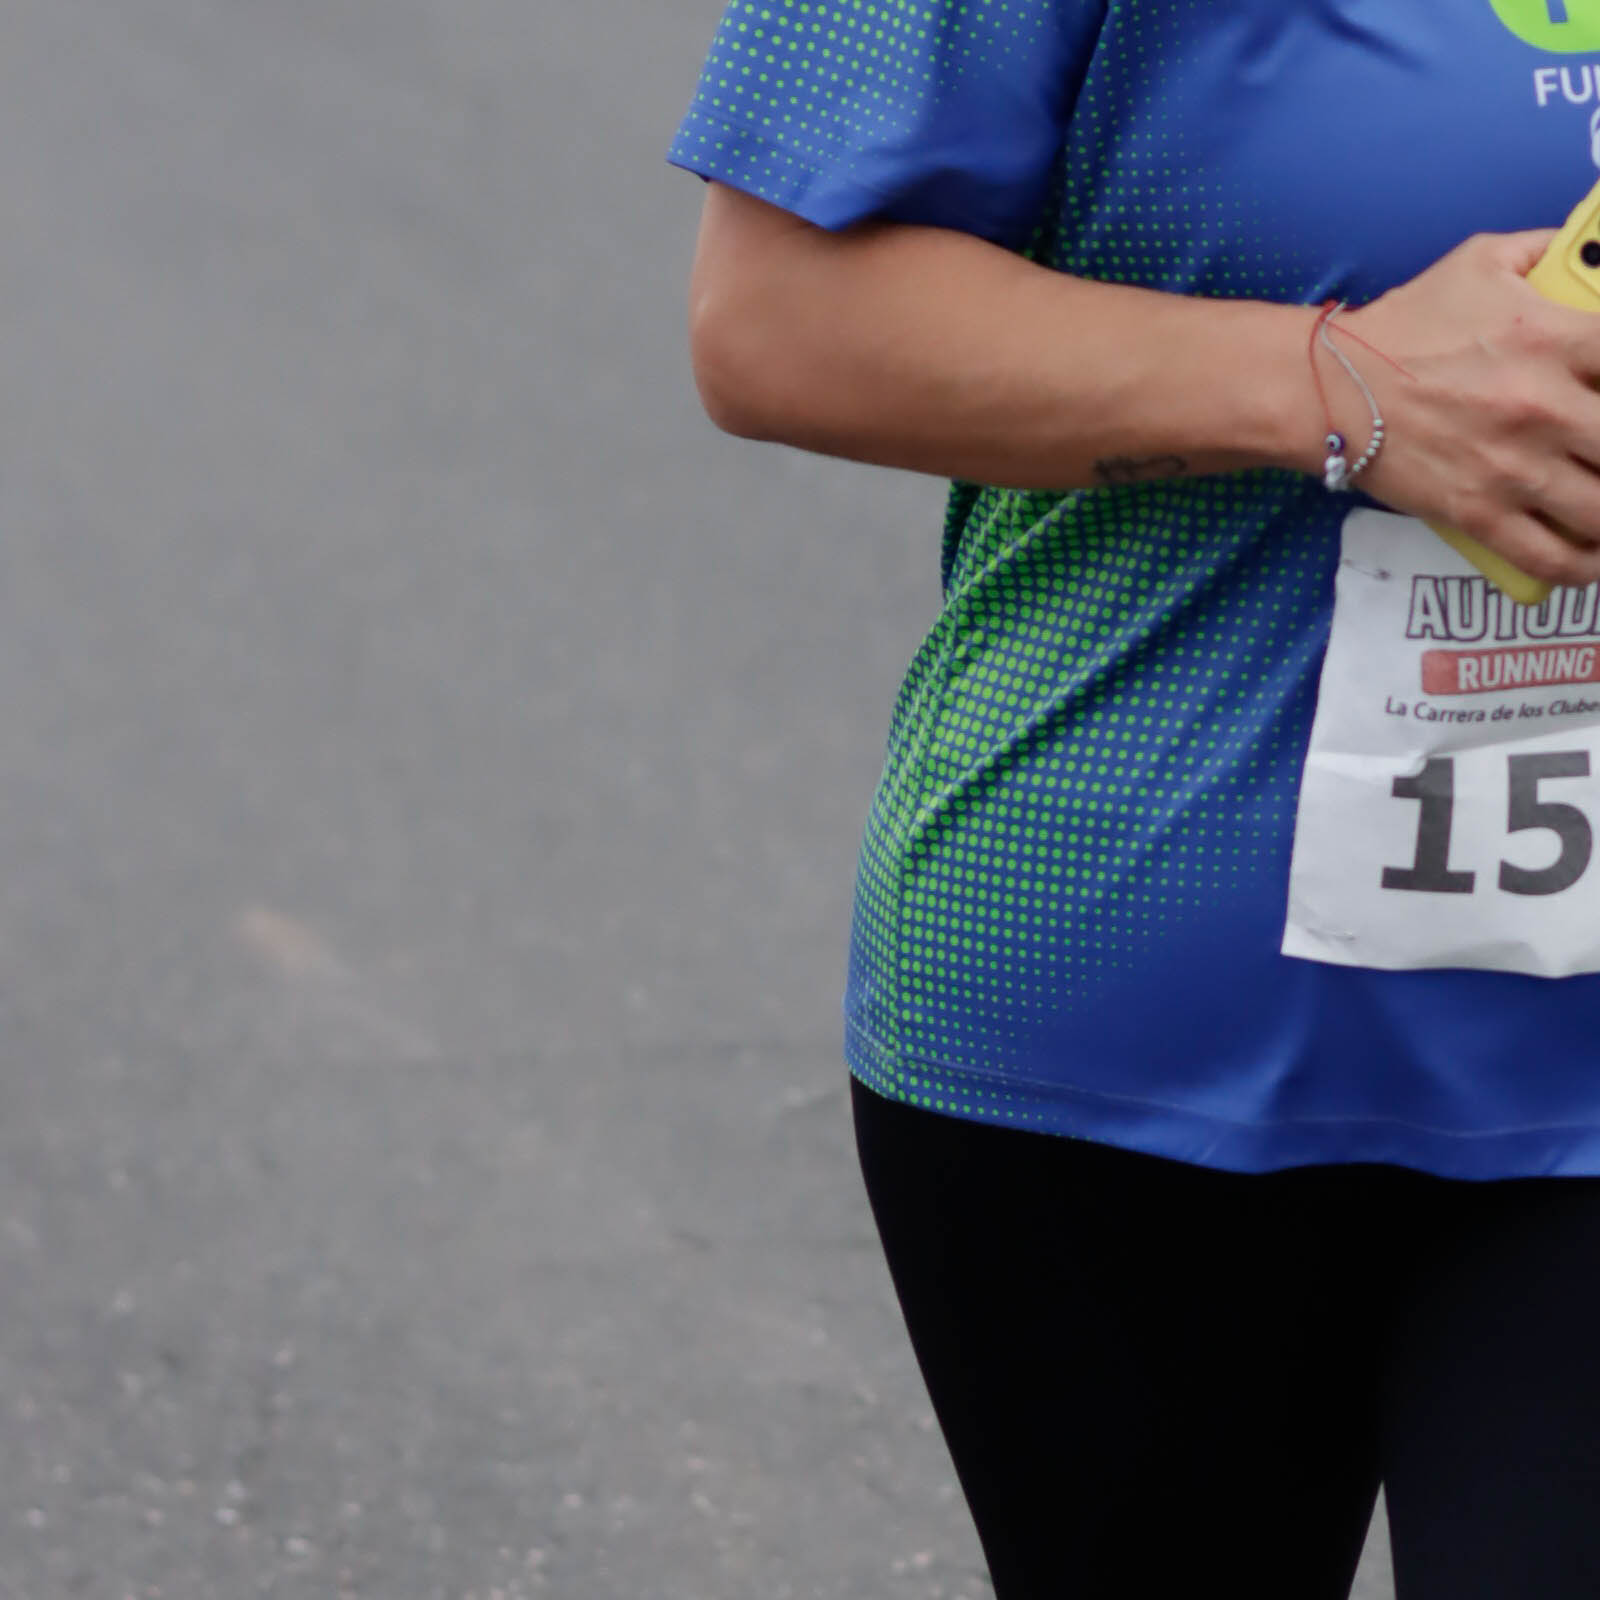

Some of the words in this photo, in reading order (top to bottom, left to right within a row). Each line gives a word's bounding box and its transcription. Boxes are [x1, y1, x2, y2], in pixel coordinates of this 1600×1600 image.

[1457, 647, 1595, 691] RUNNING
[1385, 696, 1407, 716] La
[1413, 701, 1486, 722] Carrera
[1491, 704, 1514, 721] de
[1518, 703, 1544, 718] los
